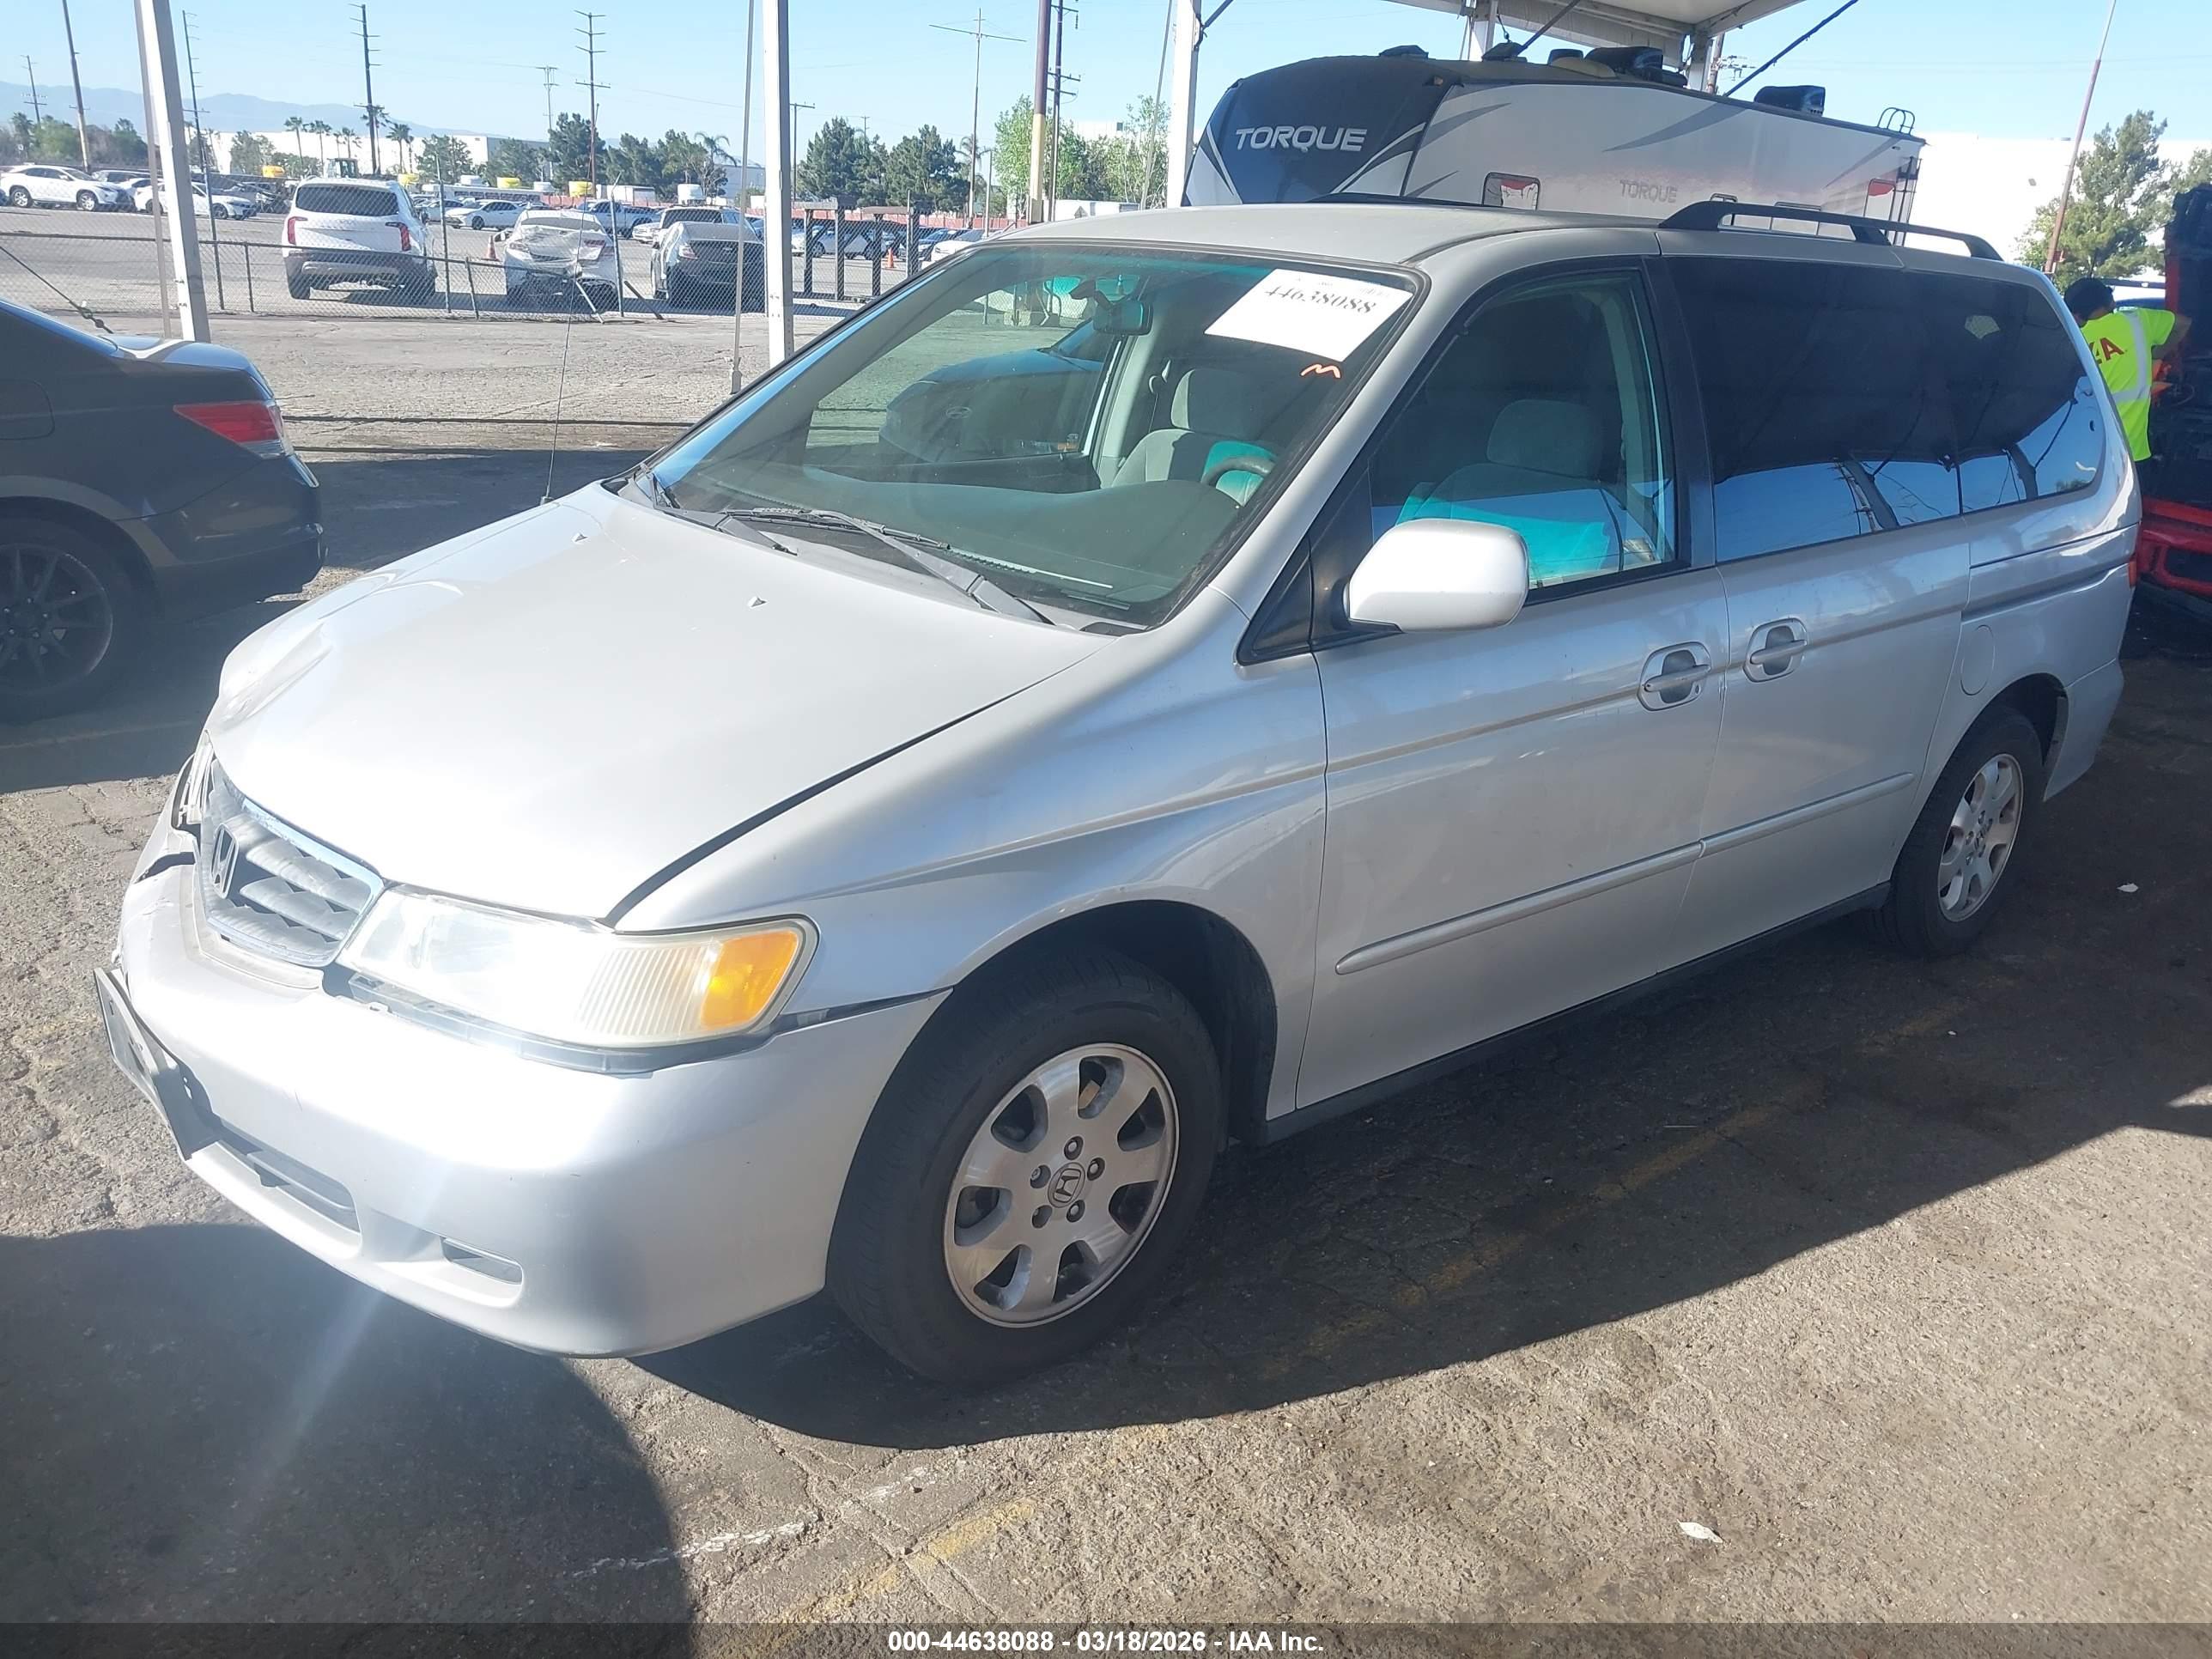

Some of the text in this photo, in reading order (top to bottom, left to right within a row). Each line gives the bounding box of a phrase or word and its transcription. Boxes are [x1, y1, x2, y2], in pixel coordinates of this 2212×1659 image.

[1236, 125, 1367, 152] TORQUE
[1620, 179, 1677, 203] TORQUE
[1265, 285, 1376, 313] 44638088
